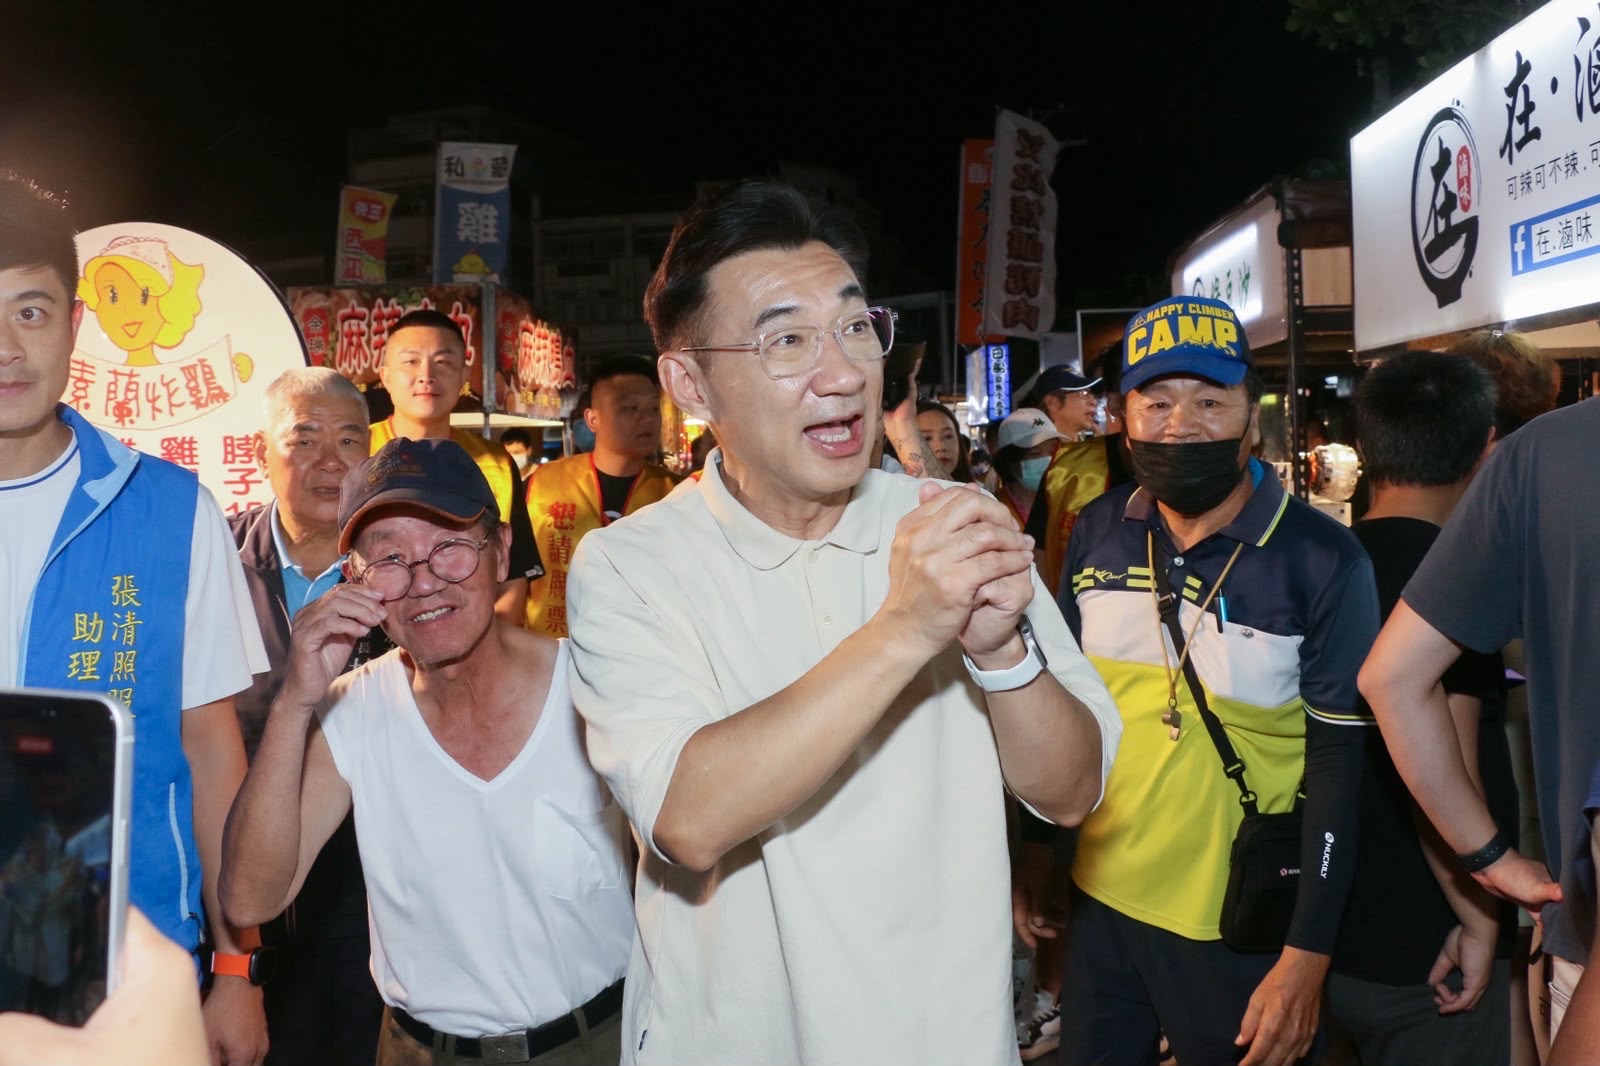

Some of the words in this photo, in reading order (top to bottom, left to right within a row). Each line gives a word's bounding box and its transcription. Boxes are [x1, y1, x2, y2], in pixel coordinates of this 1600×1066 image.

[456, 202, 499, 244] 雞
[1146, 303, 1184, 322] HAPPY
[1127, 315, 1238, 366] CAMP
[160, 436, 199, 472] 雞
[67, 612, 105, 681] 助理
[1320, 843, 1332, 879] NUCKILY
